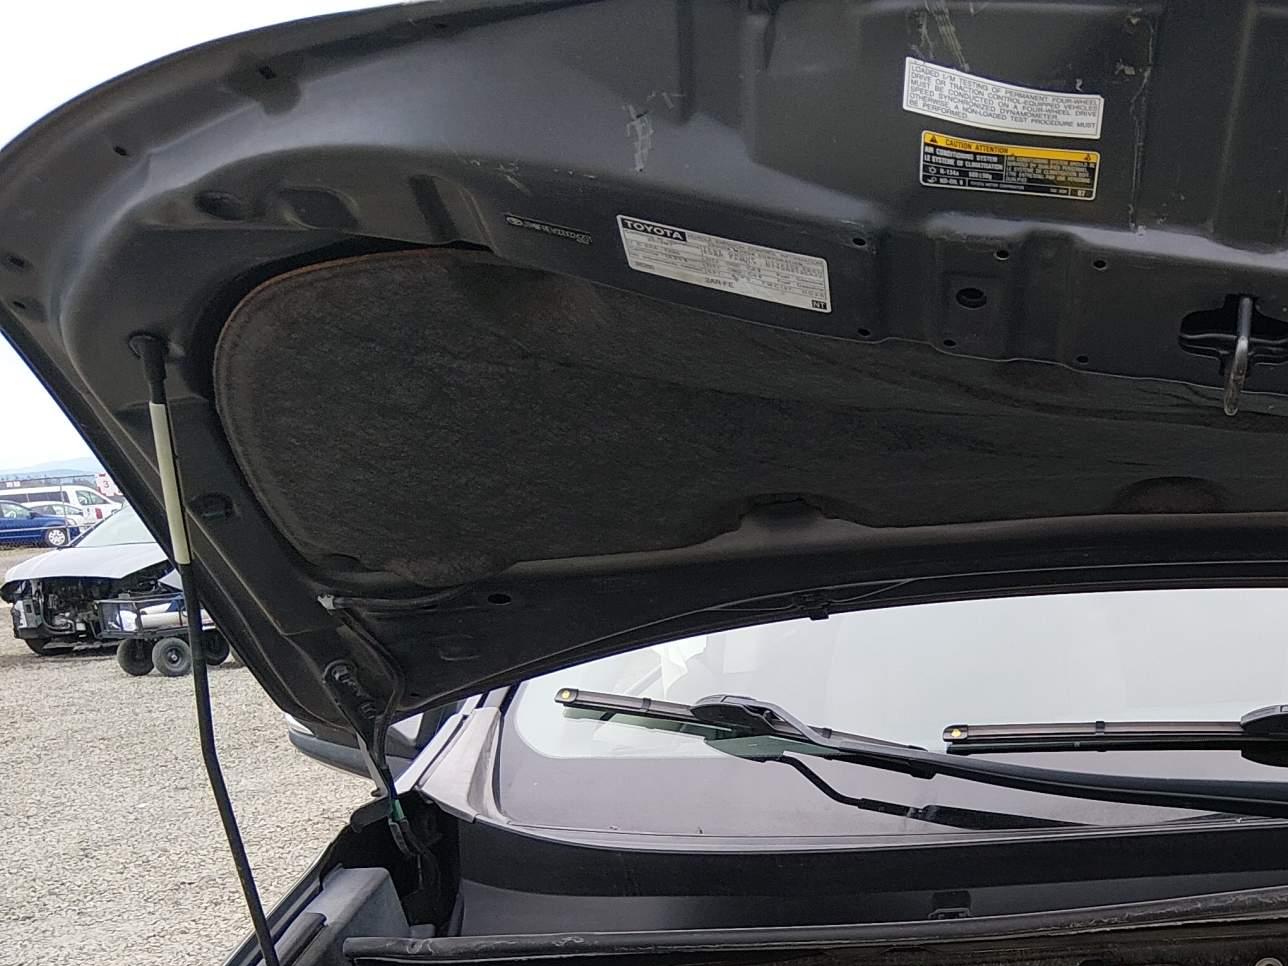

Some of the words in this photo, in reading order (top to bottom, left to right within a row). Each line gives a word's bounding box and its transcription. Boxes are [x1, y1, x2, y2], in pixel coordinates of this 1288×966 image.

[910, 86, 935, 97] SPEED
[910, 79, 930, 89] MUST
[948, 89, 994, 105] CONDUCTED
[911, 65, 940, 77] LOADED
[959, 79, 988, 91] TESTING
[1004, 90, 1048, 102] PERMANENT
[911, 72, 931, 83] DRIVE
[949, 82, 985, 96] TRACTION
[945, 139, 972, 150] CAUTION
[975, 144, 1008, 154] ATTENTION
[623, 219, 684, 240] TOYOTA
[813, 301, 826, 310] NT
